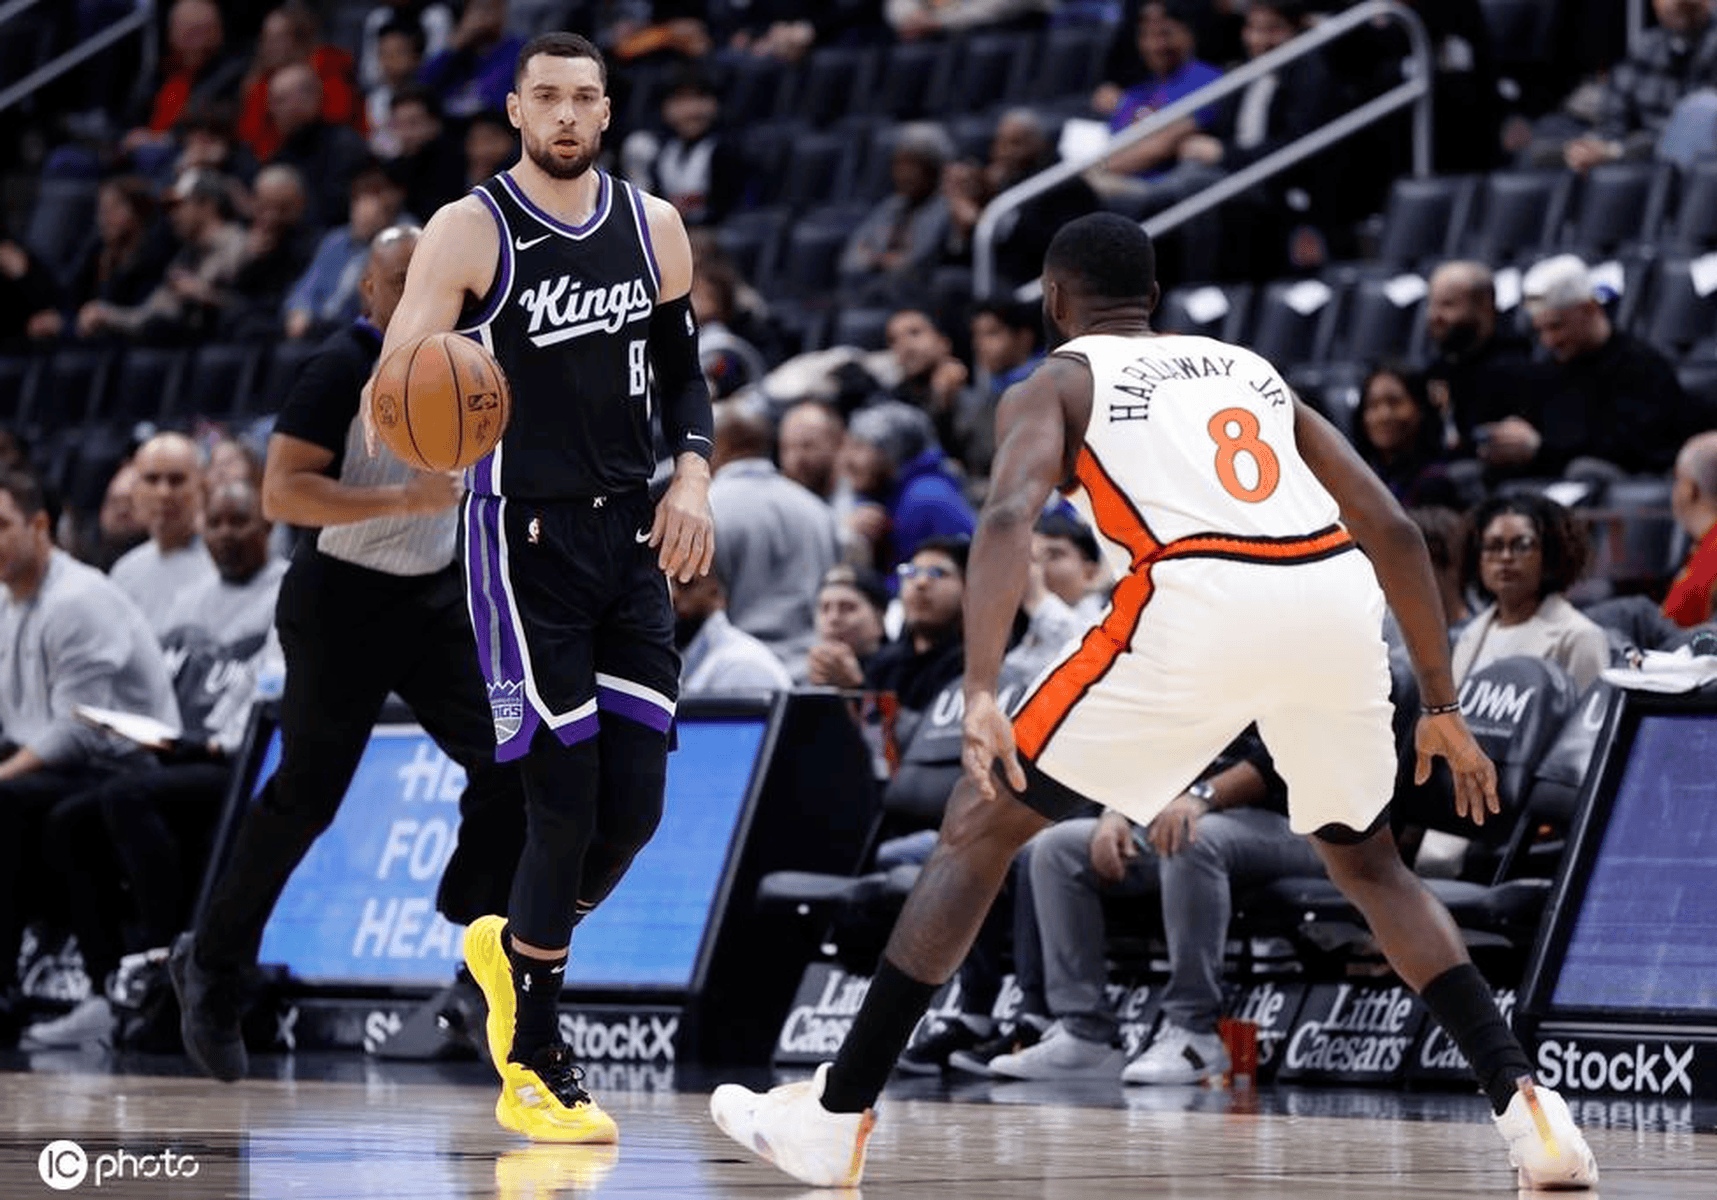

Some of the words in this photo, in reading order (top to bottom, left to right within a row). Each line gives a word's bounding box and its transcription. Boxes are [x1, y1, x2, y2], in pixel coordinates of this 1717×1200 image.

[518, 275, 652, 347] Kings
[629, 339, 647, 396] 8
[1249, 377, 1286, 407] JR
[1207, 407, 1280, 503] 8
[1458, 679, 1535, 723] UWM
[376, 818, 458, 880] FO
[352, 898, 465, 958] HEA
[1322, 983, 1412, 1032] Little
[1286, 1020, 1408, 1071] Caesars
[1536, 1040, 1694, 1095] StockX
